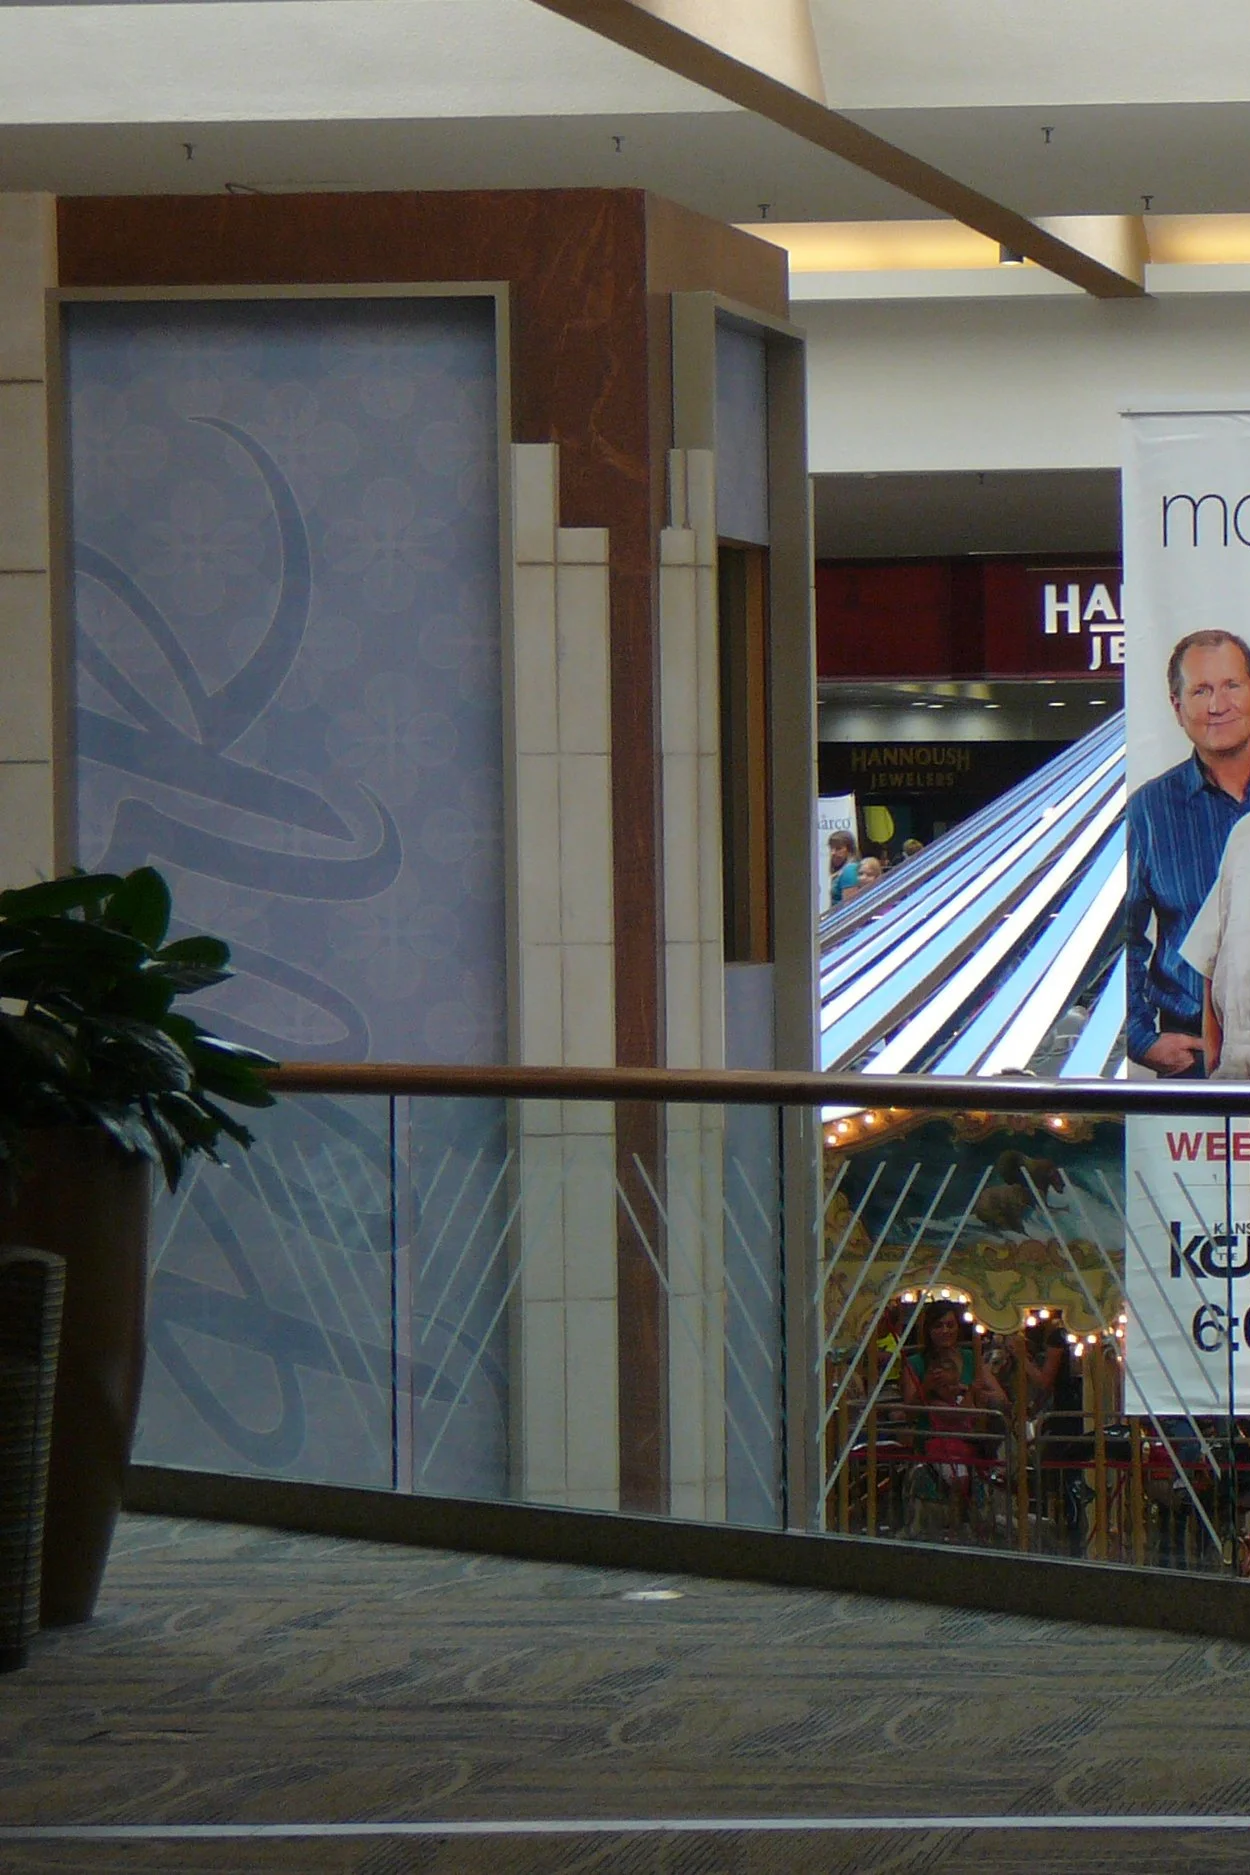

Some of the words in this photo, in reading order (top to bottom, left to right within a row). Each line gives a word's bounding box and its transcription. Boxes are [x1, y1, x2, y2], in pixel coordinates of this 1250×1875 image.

[1044, 584, 1124, 634] HA
[851, 747, 971, 772] HANNOUSH
[871, 772, 955, 790] JEWELERS
